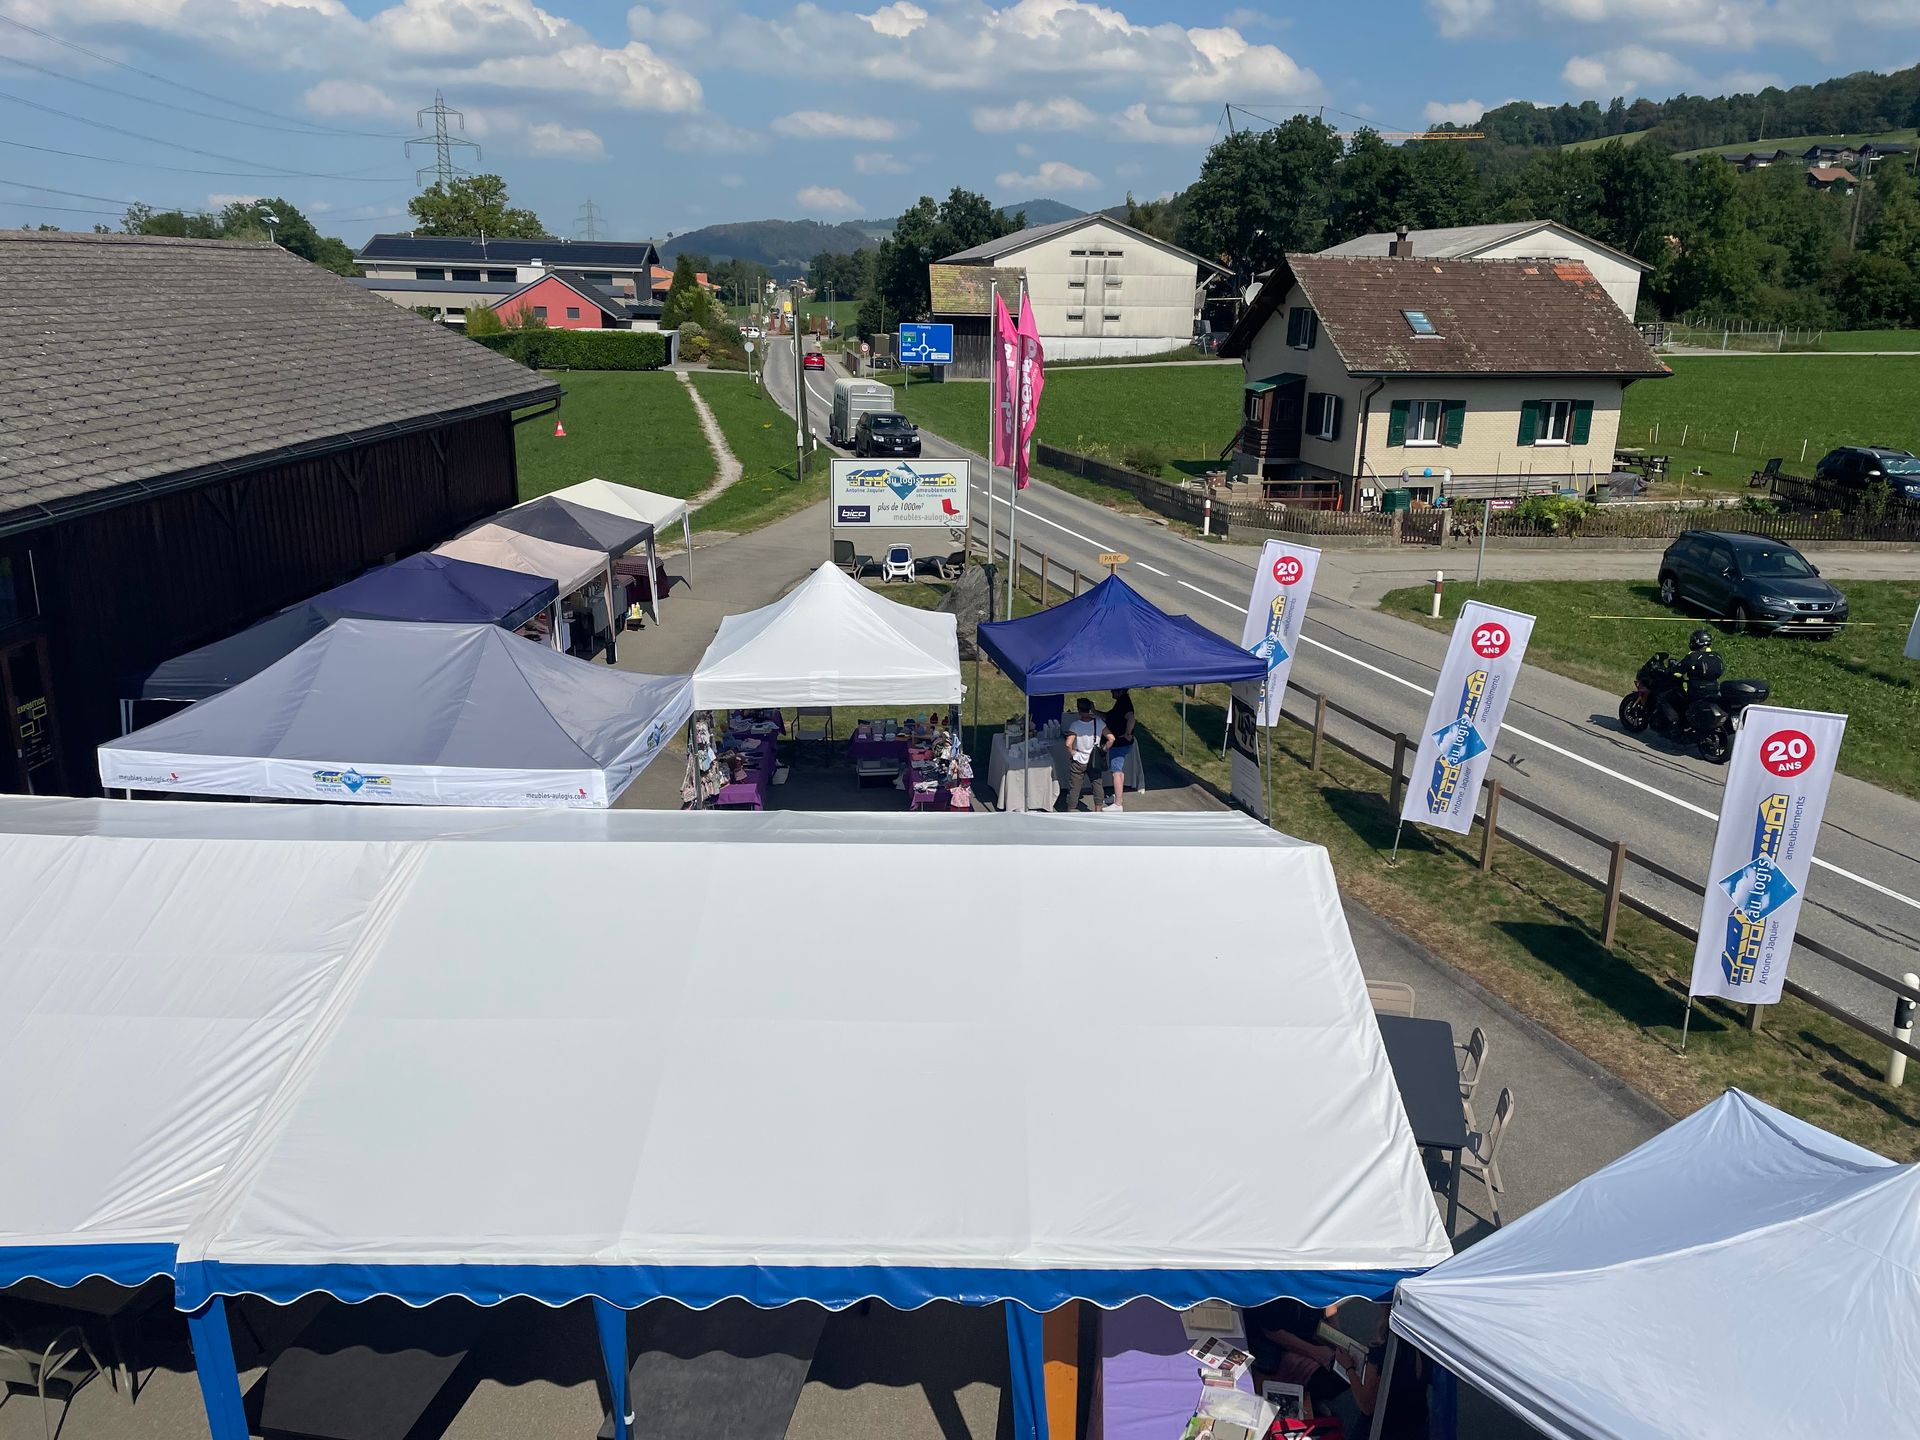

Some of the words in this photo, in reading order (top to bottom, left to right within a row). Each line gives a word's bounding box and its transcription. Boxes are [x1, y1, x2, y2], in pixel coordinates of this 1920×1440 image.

[900, 476, 919, 485] logis
[842, 509, 867, 517] bico
[877, 503, 890, 512] plus
[891, 502, 899, 511] de
[893, 512, 964, 522] meubles-aulogis.com
[1276, 561, 1299, 576] 20
[1264, 634, 1278, 659] logis
[1476, 629, 1506, 646] 20
[1480, 675, 1501, 723] ameublements
[1453, 718, 1470, 747] logis
[1449, 749, 1460, 764] au
[1767, 738, 1808, 763] 20
[1777, 761, 1803, 772] ANS
[525, 792, 587, 800] meubles-aulogis.com
[1452, 791, 1465, 816] Antoine
[1459, 766, 1472, 791] Jaquier
[1785, 796, 1806, 860] ameublements
[1752, 858, 1772, 897] logis
[1748, 897, 1761, 919] au
[1758, 951, 1772, 985] Antoine
[1766, 920, 1780, 951] Jaquier
